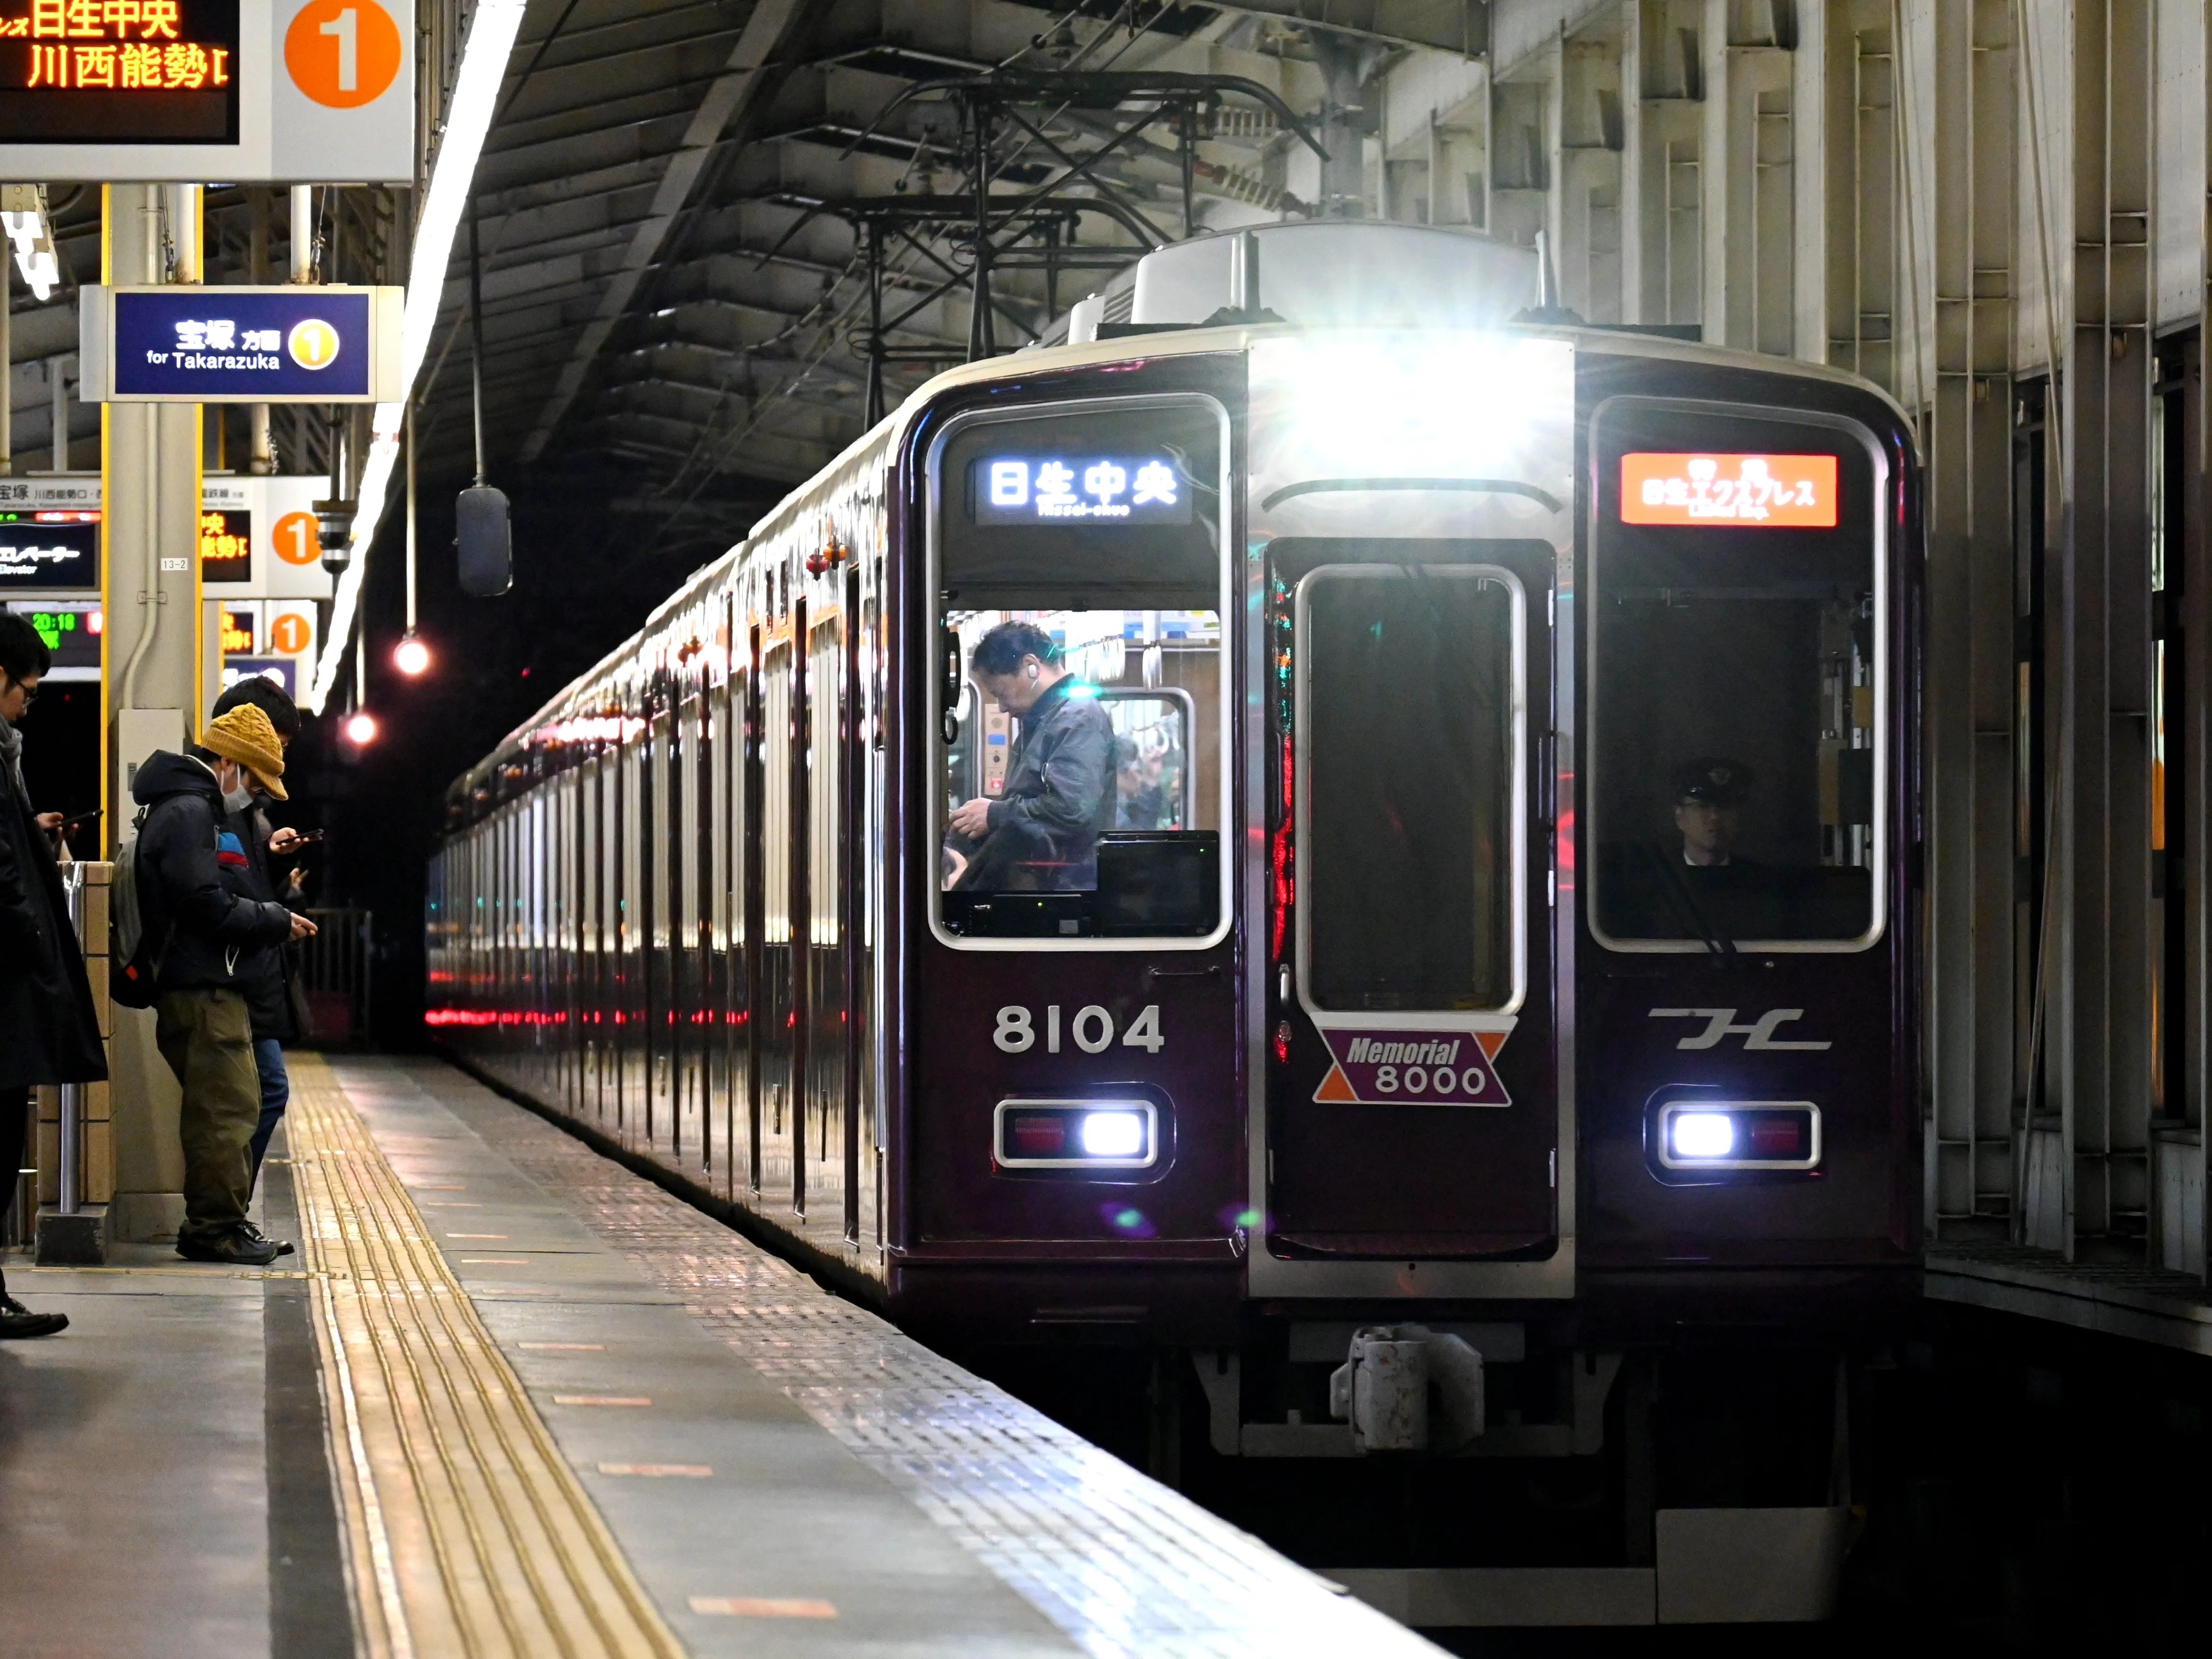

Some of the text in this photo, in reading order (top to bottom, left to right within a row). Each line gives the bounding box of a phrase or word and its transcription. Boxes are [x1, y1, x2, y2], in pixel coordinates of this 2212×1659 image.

[34, 0, 178, 38] 日生中央
[319, 8, 357, 91] 1
[175, 320, 235, 350] 宝塚
[302, 324, 320, 362] 1
[147, 350, 279, 369] for Takarazuka
[992, 461, 1177, 505] 日生中央
[287, 519, 306, 558] 1
[164, 560, 185, 568] 13-2
[33, 613, 75, 630] 20:18
[282, 618, 297, 649] 1
[993, 1005, 1165, 1054] 8104
[1347, 1037, 1460, 1066] Memorial
[1375, 1065, 1487, 1095] 8000
